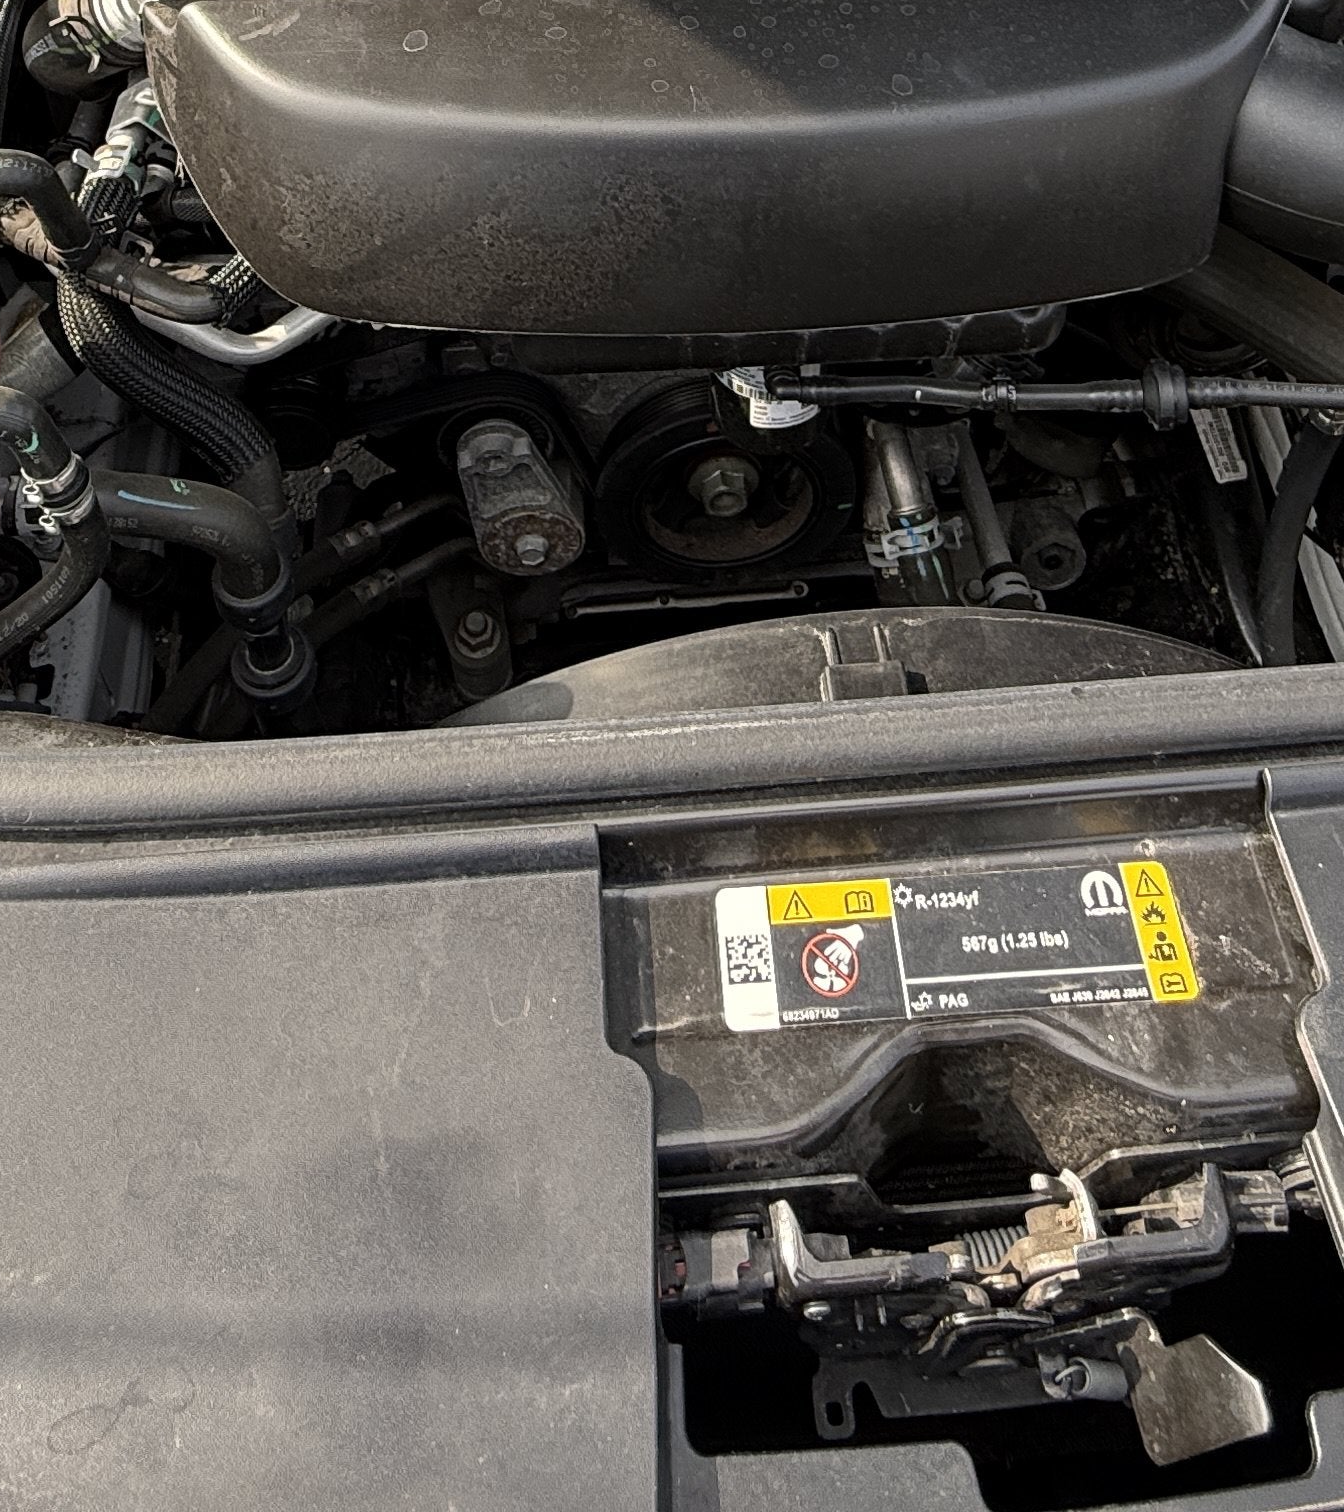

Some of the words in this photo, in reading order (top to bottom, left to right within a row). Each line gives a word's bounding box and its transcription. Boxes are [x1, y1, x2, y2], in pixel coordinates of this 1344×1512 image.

[914, 890, 979, 910] R-1234yf
[961, 935, 999, 954] 567g
[1000, 932, 1038, 953] (1.25
[1039, 929, 1069, 949] lbs)
[939, 992, 969, 1009] PAG
